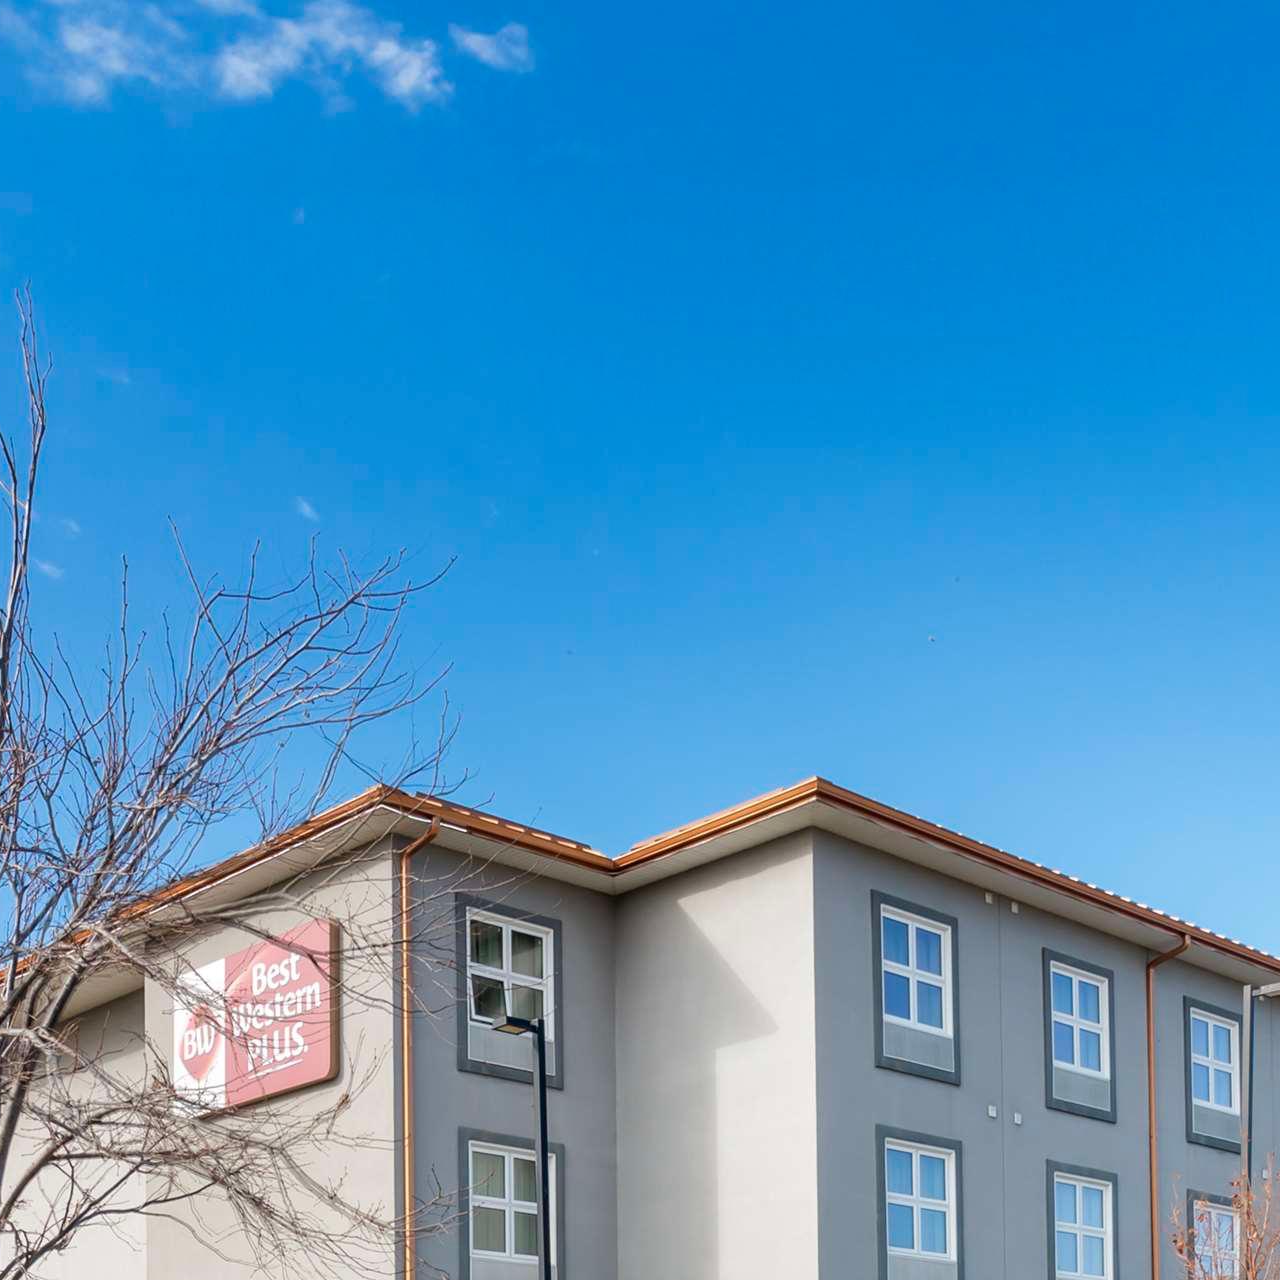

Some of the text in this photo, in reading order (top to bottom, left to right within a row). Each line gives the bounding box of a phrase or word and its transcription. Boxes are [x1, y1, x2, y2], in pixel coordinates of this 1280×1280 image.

[252, 953, 300, 996] Best
[232, 981, 322, 1036] Western
[183, 1023, 215, 1060] BW
